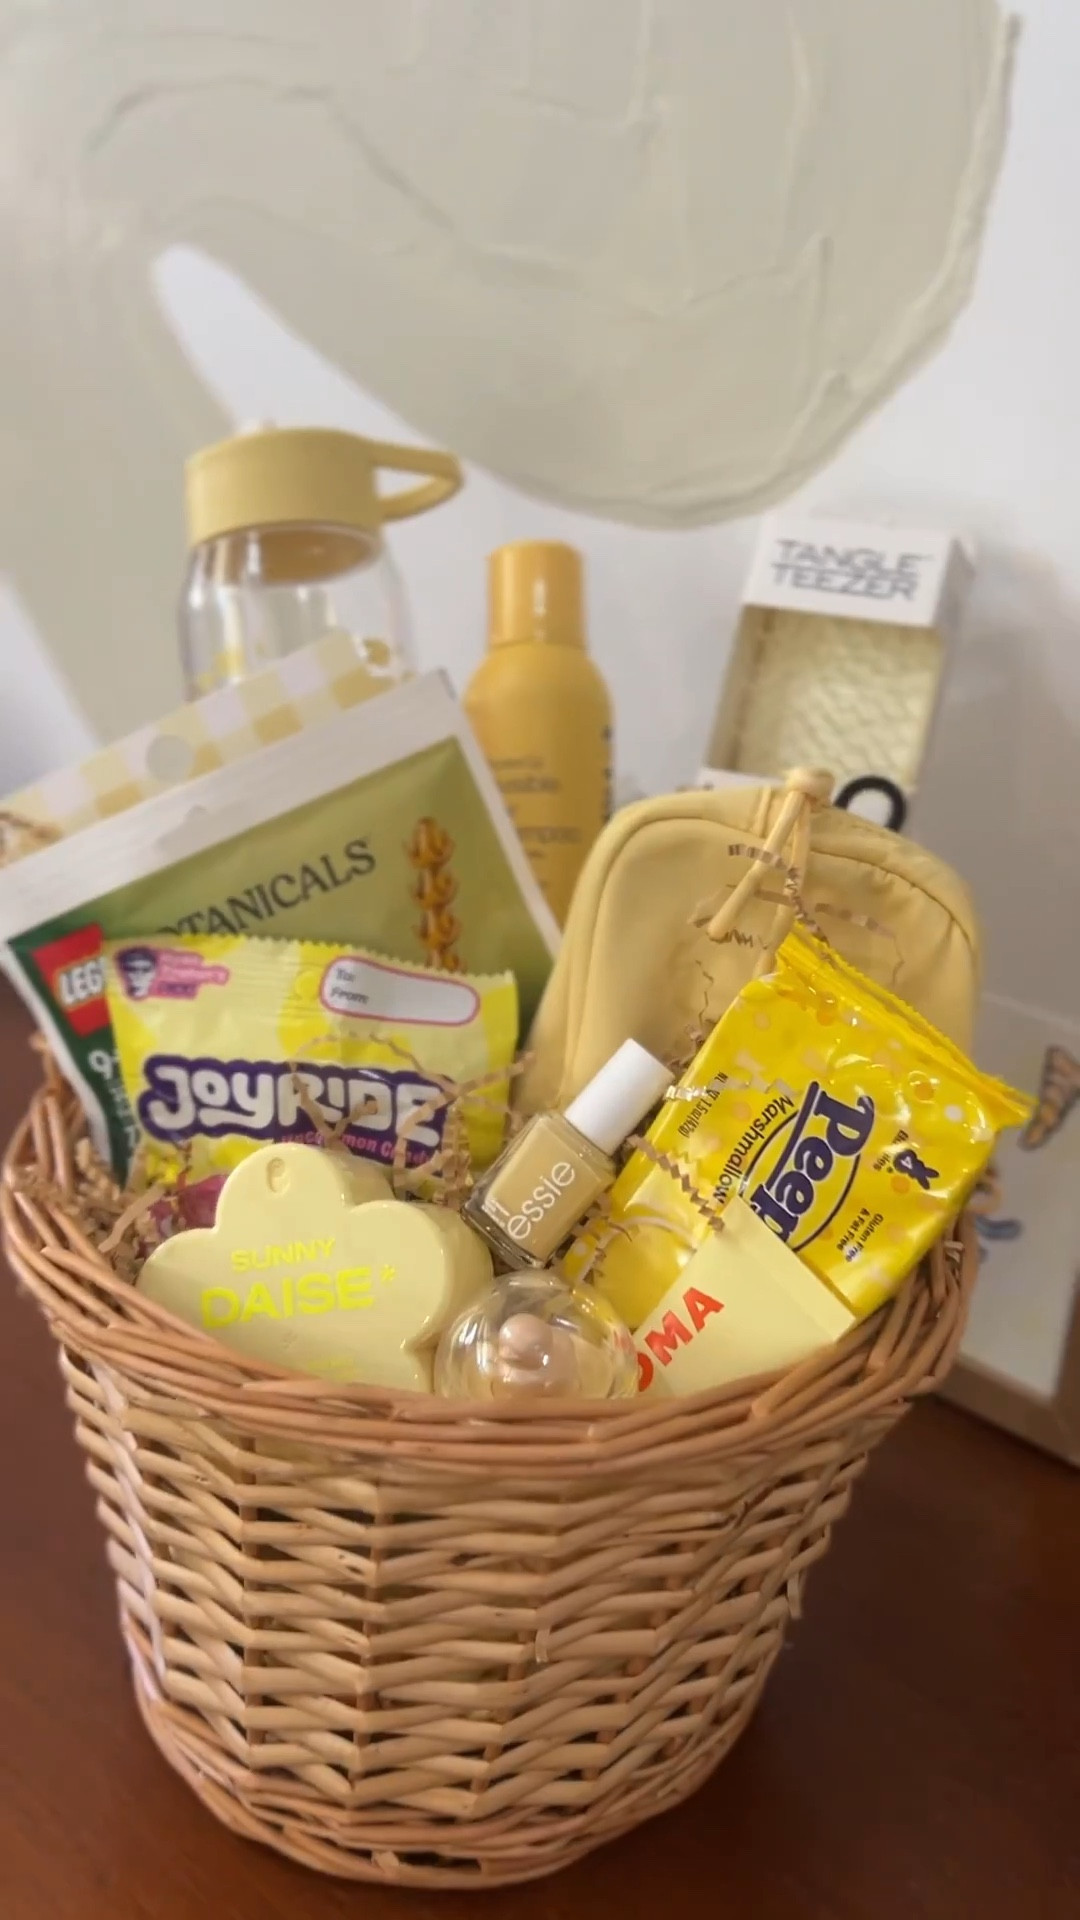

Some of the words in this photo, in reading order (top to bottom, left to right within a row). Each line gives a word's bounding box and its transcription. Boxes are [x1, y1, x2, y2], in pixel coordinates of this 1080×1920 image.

[776, 539, 929, 572] TANGLE
[771, 563, 919, 600] TEEZER
[156, 838, 376, 936] TANICALS
[713, 1094, 794, 1204] Marshmallow
[750, 1090, 875, 1242] Peep
[901, 1156, 912, 1169] 4
[507, 1161, 575, 1239] essie
[836, 1229, 855, 1251] Free
[850, 1215, 865, 1232] Fat
[860, 1213, 884, 1242] Gluten
[231, 1237, 335, 1273] SUNNY
[846, 1241, 864, 1262] Free
